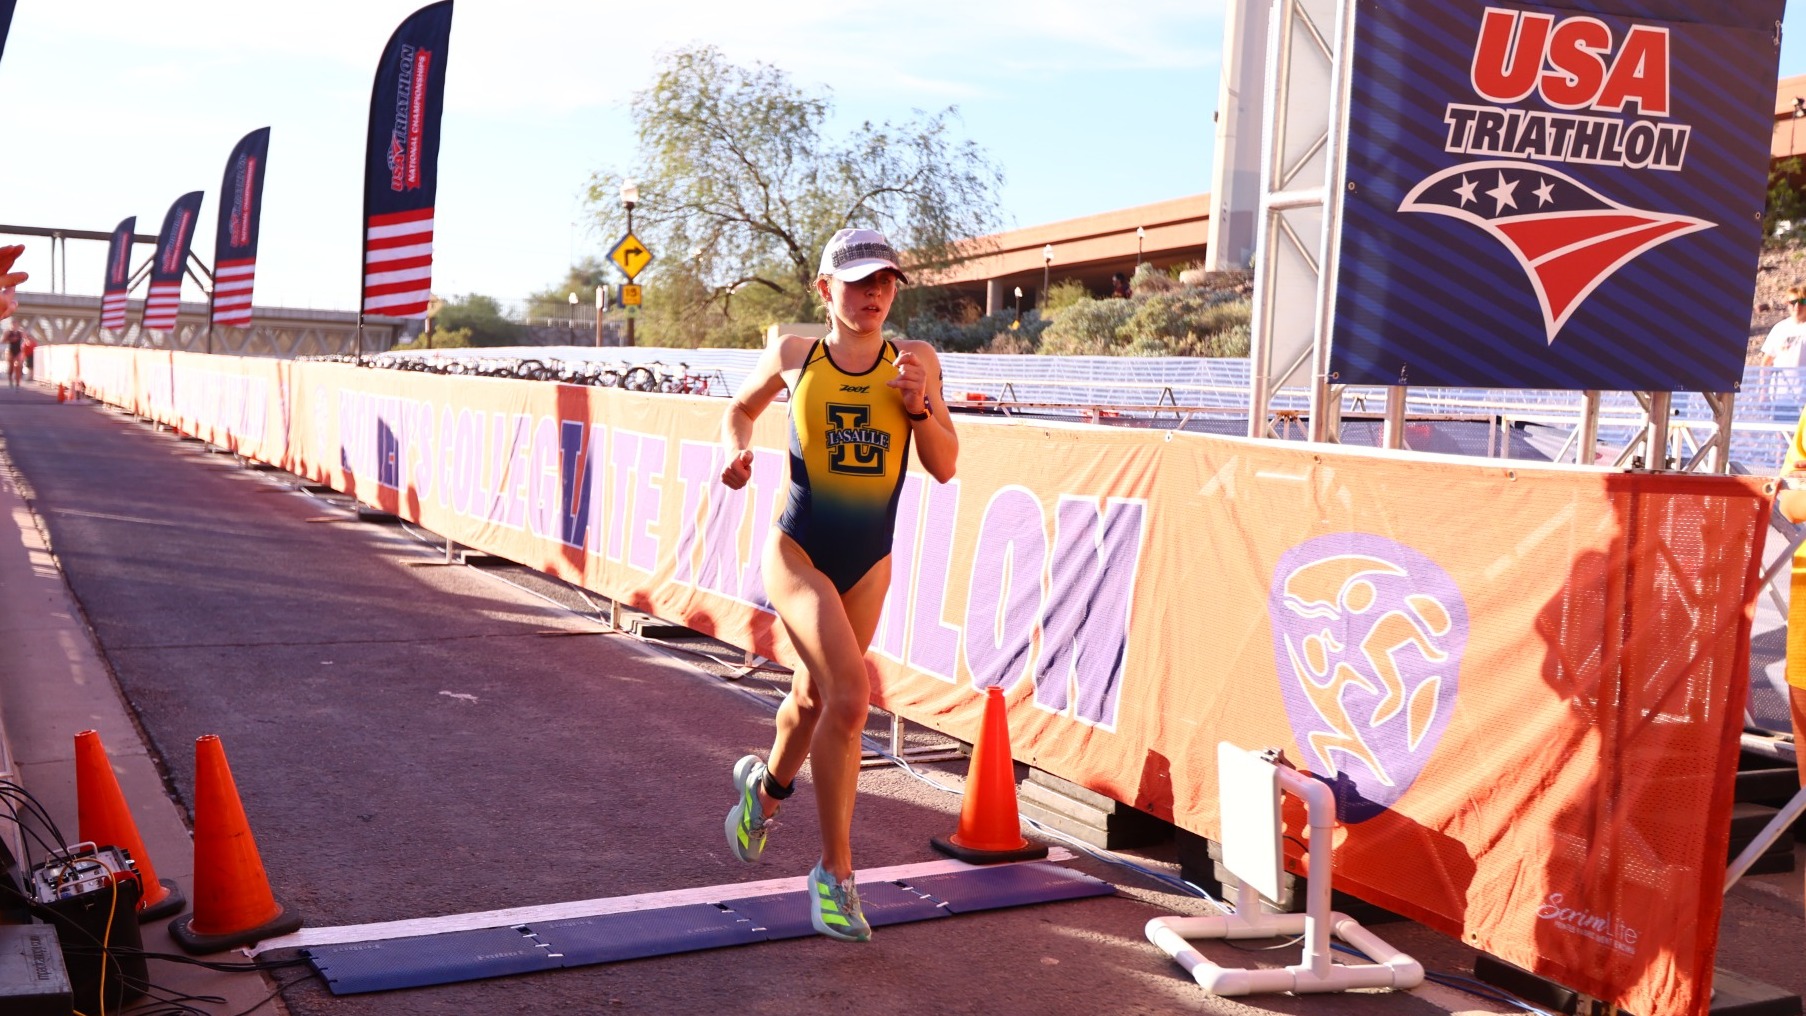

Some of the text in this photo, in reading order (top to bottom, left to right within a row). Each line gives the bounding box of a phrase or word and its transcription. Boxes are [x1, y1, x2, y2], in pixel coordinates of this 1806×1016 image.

[390, 43, 415, 192] USA TRIATHLON
[407, 55, 427, 183] NATIONAL CHAMPIONSHIPS
[1470, 6, 1670, 118] USA
[1444, 102, 1692, 172] TRIATHLON
[438, 402, 666, 575] COLLEGIATE
[671, 438, 1148, 734] TRILON
